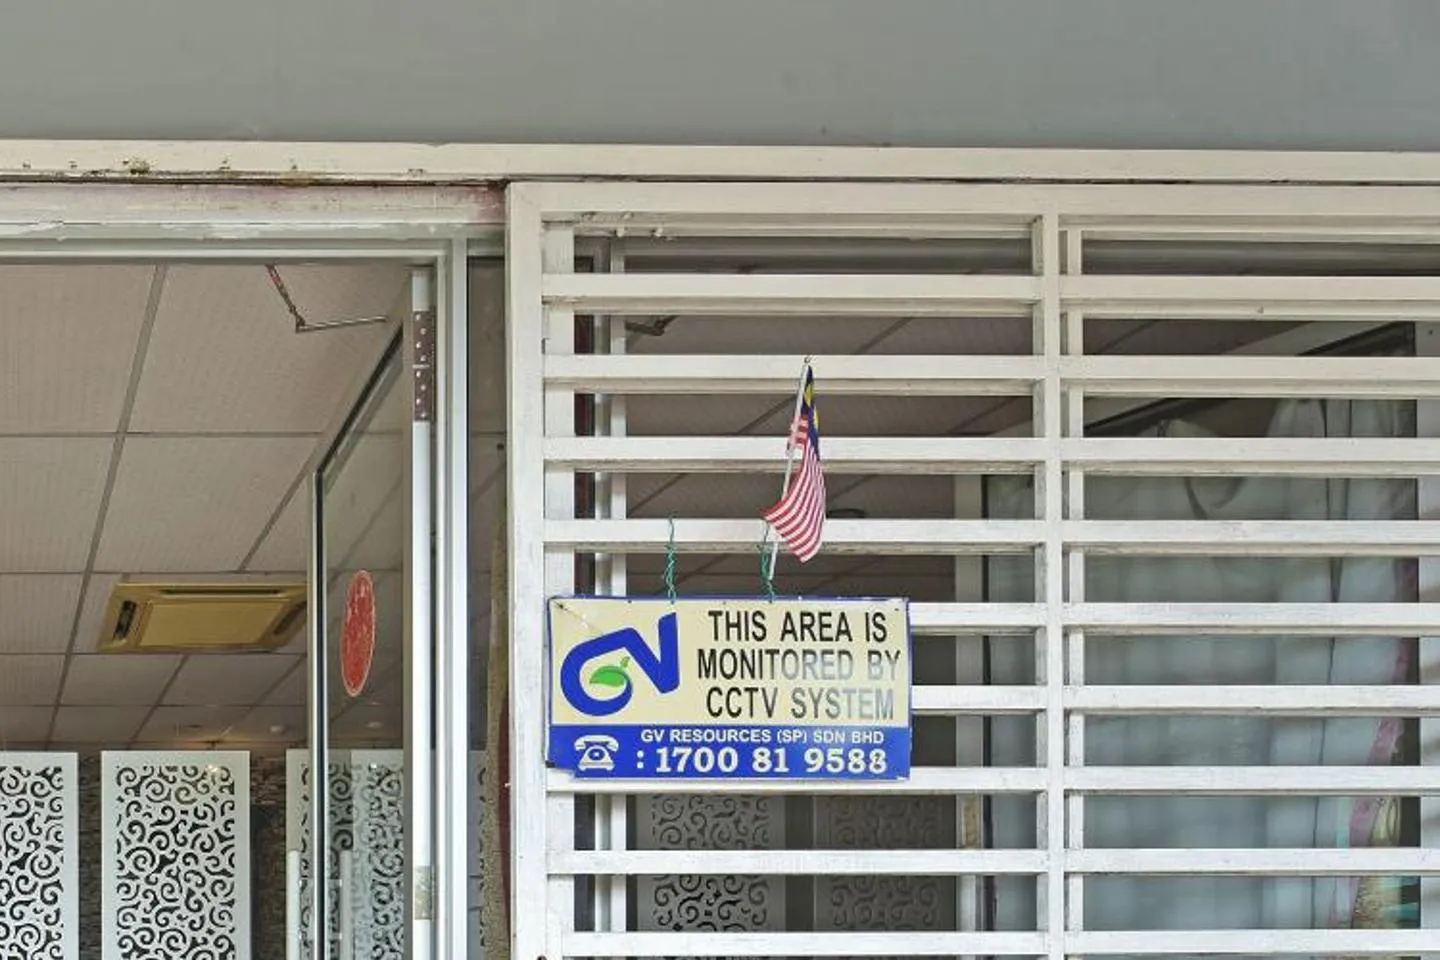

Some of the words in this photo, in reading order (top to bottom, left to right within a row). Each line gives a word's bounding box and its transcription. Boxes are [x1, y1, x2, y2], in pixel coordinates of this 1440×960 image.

[708, 610, 766, 642] THIS
[780, 611, 852, 642] AREA
[864, 611, 887, 642] IS
[697, 648, 854, 681] MONITORED
[867, 649, 901, 681] BY
[706, 687, 777, 718] CCTV
[791, 687, 894, 720] SYSTEM
[640, 729, 665, 743] GV
[669, 729, 772, 744] RESOURCES
[776, 729, 807, 744] (SP)
[813, 730, 846, 744] SDN
[851, 731, 885, 745] BHD
[655, 746, 739, 773] 1700
[751, 747, 790, 773] 81
[803, 747, 888, 774] 9588
